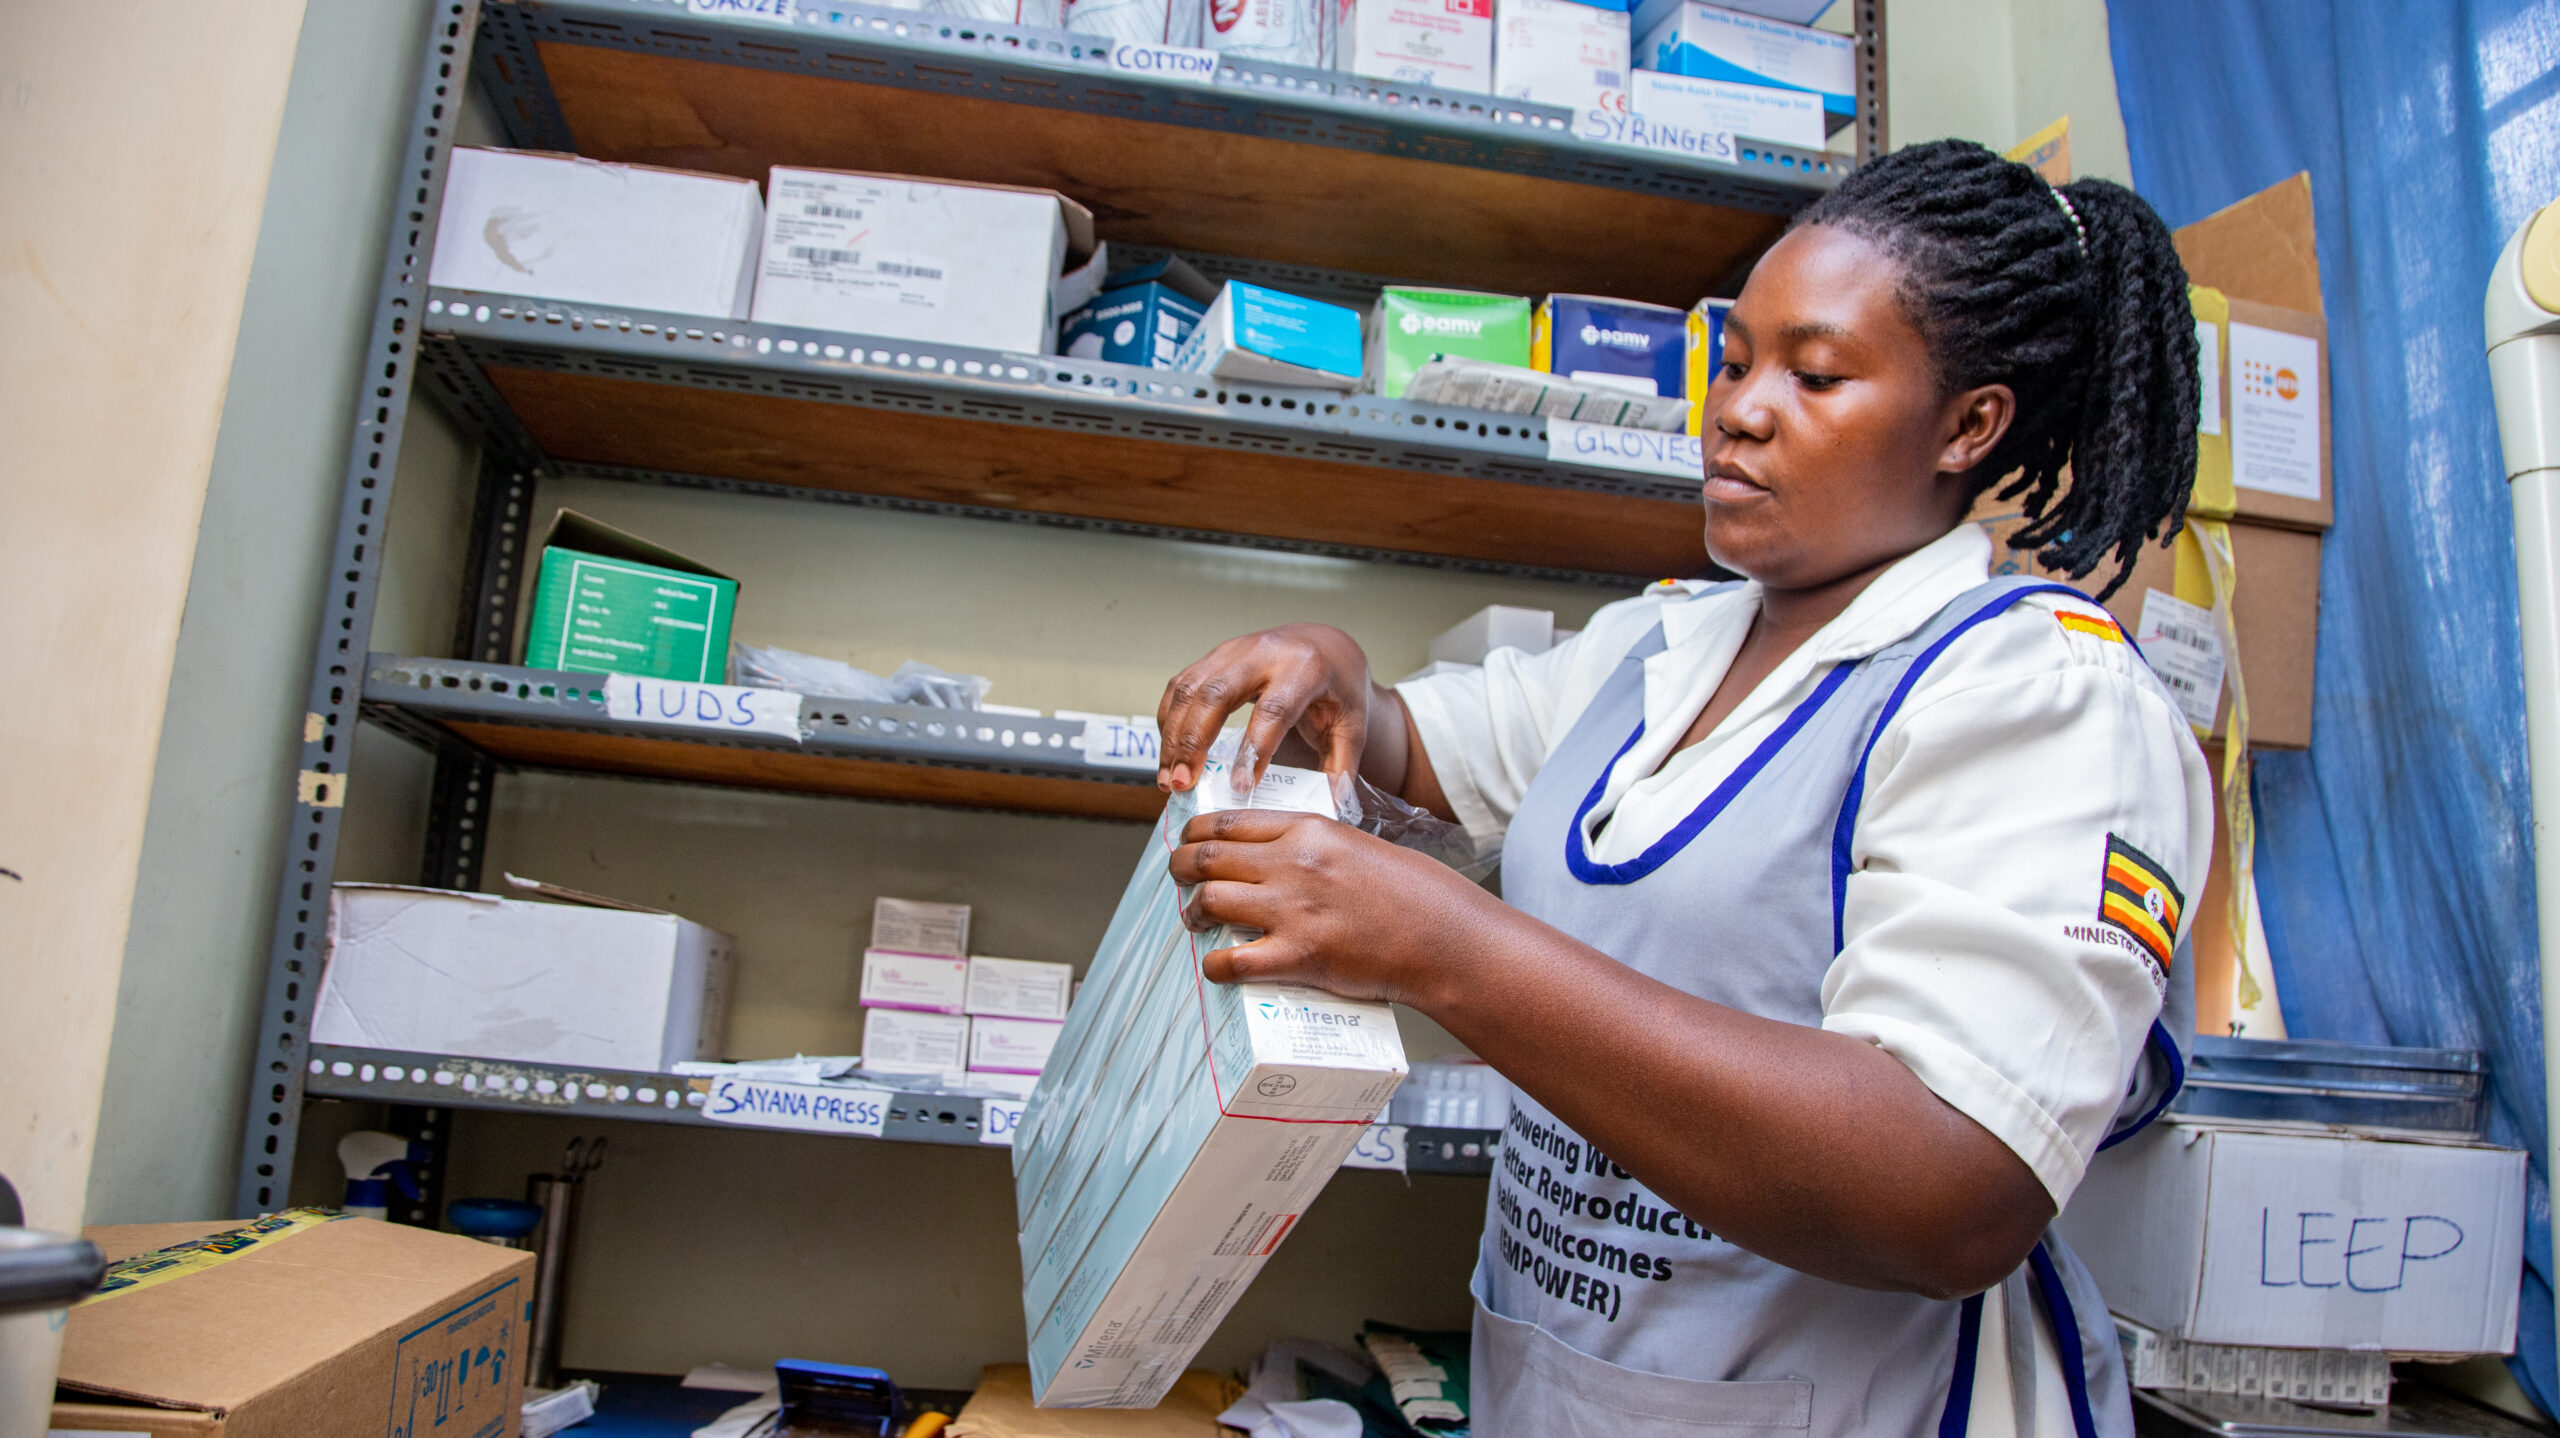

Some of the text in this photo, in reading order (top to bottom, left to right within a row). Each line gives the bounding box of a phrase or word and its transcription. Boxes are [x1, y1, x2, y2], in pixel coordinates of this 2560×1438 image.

[1117, 45, 1213, 72] COTTON
[1585, 109, 1731, 157] SYRINGES
[1575, 424, 1702, 469] GLOVES
[635, 681, 755, 727] IUDS
[1105, 725, 1157, 759] IM
[2064, 925, 2139, 955] MINISTRY
[713, 1082, 880, 1126] SAYANA PRESS
[989, 1106, 1024, 1135] DE
[1509, 1098, 1580, 1175] powering
[1503, 1137, 1535, 1190] etter
[1527, 1207, 1673, 1282] Outcomes
[2261, 1207, 2464, 1293] LEEP
[1500, 1223, 1621, 1322] (EMPOWER)
[1088, 1320, 1123, 1359] Mirena
